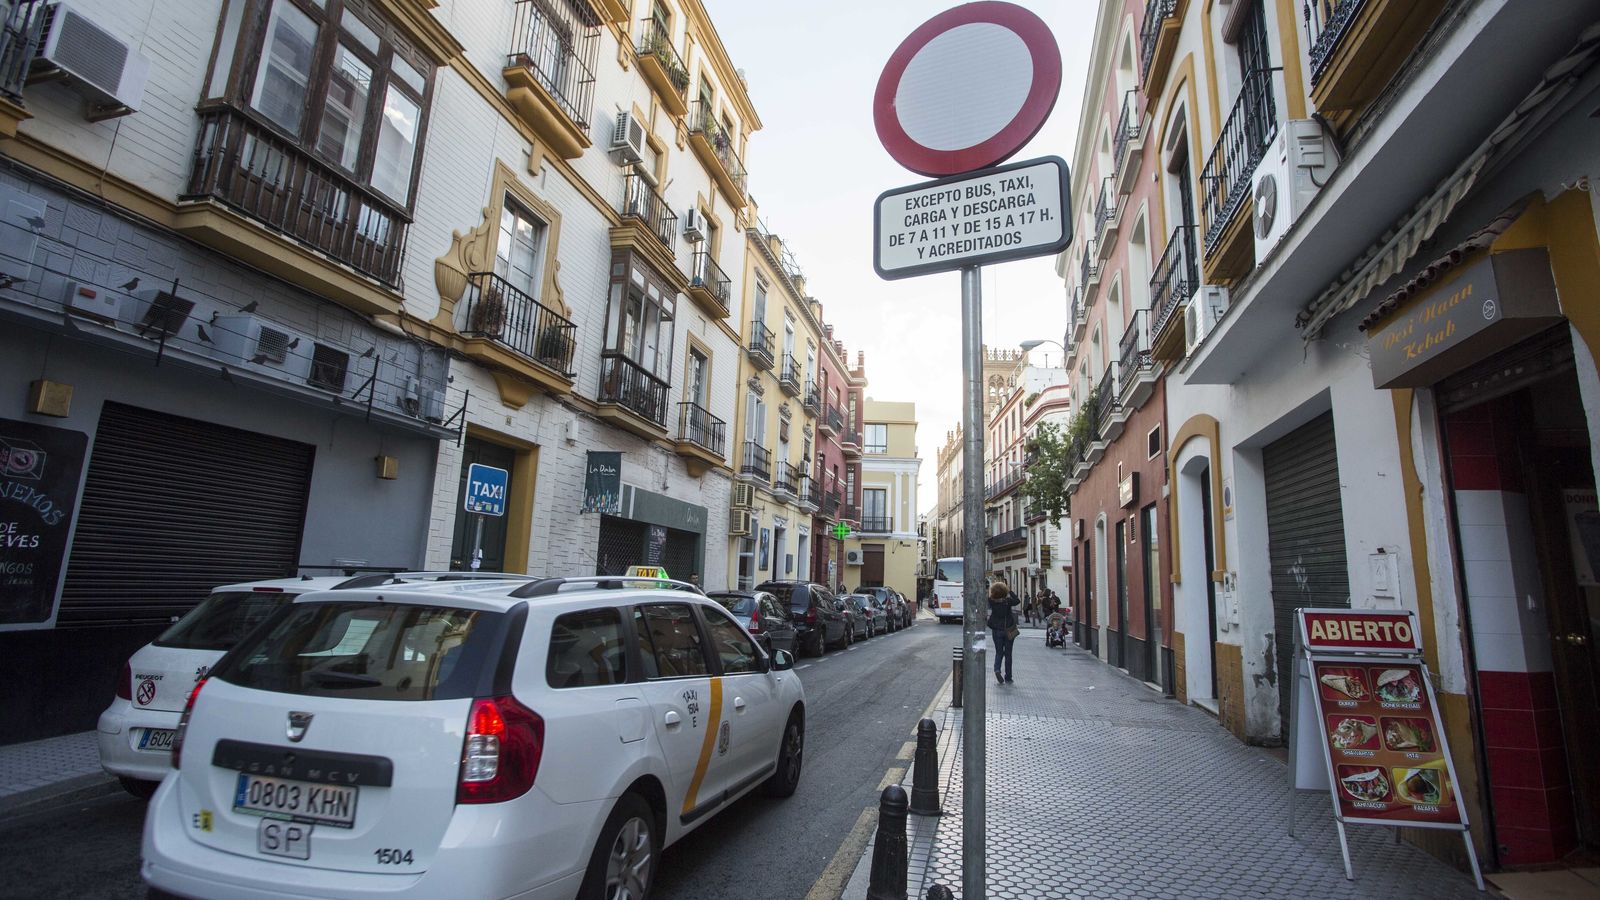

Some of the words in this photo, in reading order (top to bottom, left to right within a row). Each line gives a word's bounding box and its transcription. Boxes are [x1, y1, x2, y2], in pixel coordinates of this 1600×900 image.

[905, 189, 961, 210] EXCEPTO
[965, 183, 995, 200] BUS,
[999, 175, 1034, 193] TAXI,
[904, 209, 947, 227] CARGA
[951, 207, 959, 219] Y
[963, 192, 1035, 217] DESCARGA
[889, 234, 904, 247] DE
[908, 231, 916, 244] 7
[919, 229, 929, 242] A
[934, 226, 946, 240] 11
[951, 224, 960, 236] Y
[964, 221, 980, 235] DE
[985, 217, 1000, 231] 15
[1005, 214, 1015, 227] A
[1019, 211, 1035, 225] 17
[1040, 208, 1054, 222] H.
[917, 247, 925, 260] Y
[929, 231, 1022, 258] ACREDITADOS
[1402, 320, 1456, 360] Kebab
[472, 481, 504, 500] TAXI
[638, 568, 658, 578] TAXI
[1311, 619, 1412, 643] ABIERTO
[135, 673, 164, 681] PEUGEOT
[683, 689, 698, 703] TAXI
[688, 702, 700, 715] 1504
[692, 716, 697, 728] E
[150, 731, 174, 748] 604
[307, 768, 360, 783] MCV
[249, 780, 300, 810] 0803
[306, 787, 352, 818] KHN
[264, 824, 303, 852] SP
[373, 848, 414, 865] 1504
